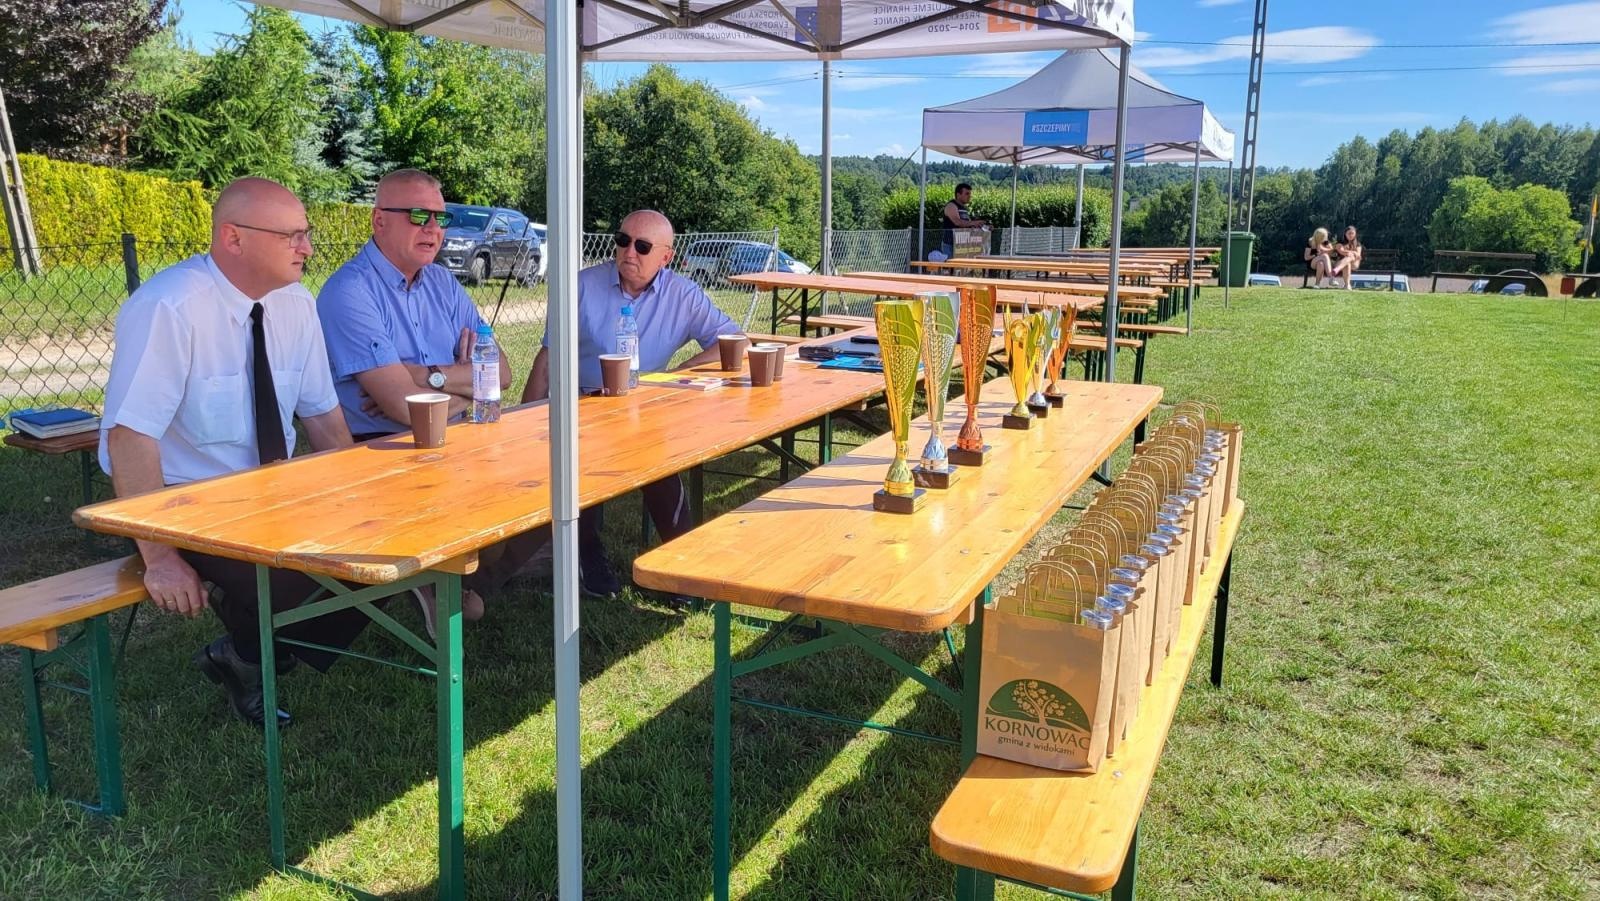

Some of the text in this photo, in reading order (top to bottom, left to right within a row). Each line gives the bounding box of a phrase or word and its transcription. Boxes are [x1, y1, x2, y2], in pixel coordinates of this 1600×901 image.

[985, 717, 1091, 750] KORNOWAC
[998, 737, 1023, 746] gmina
[1034, 744, 1075, 755] widokami
